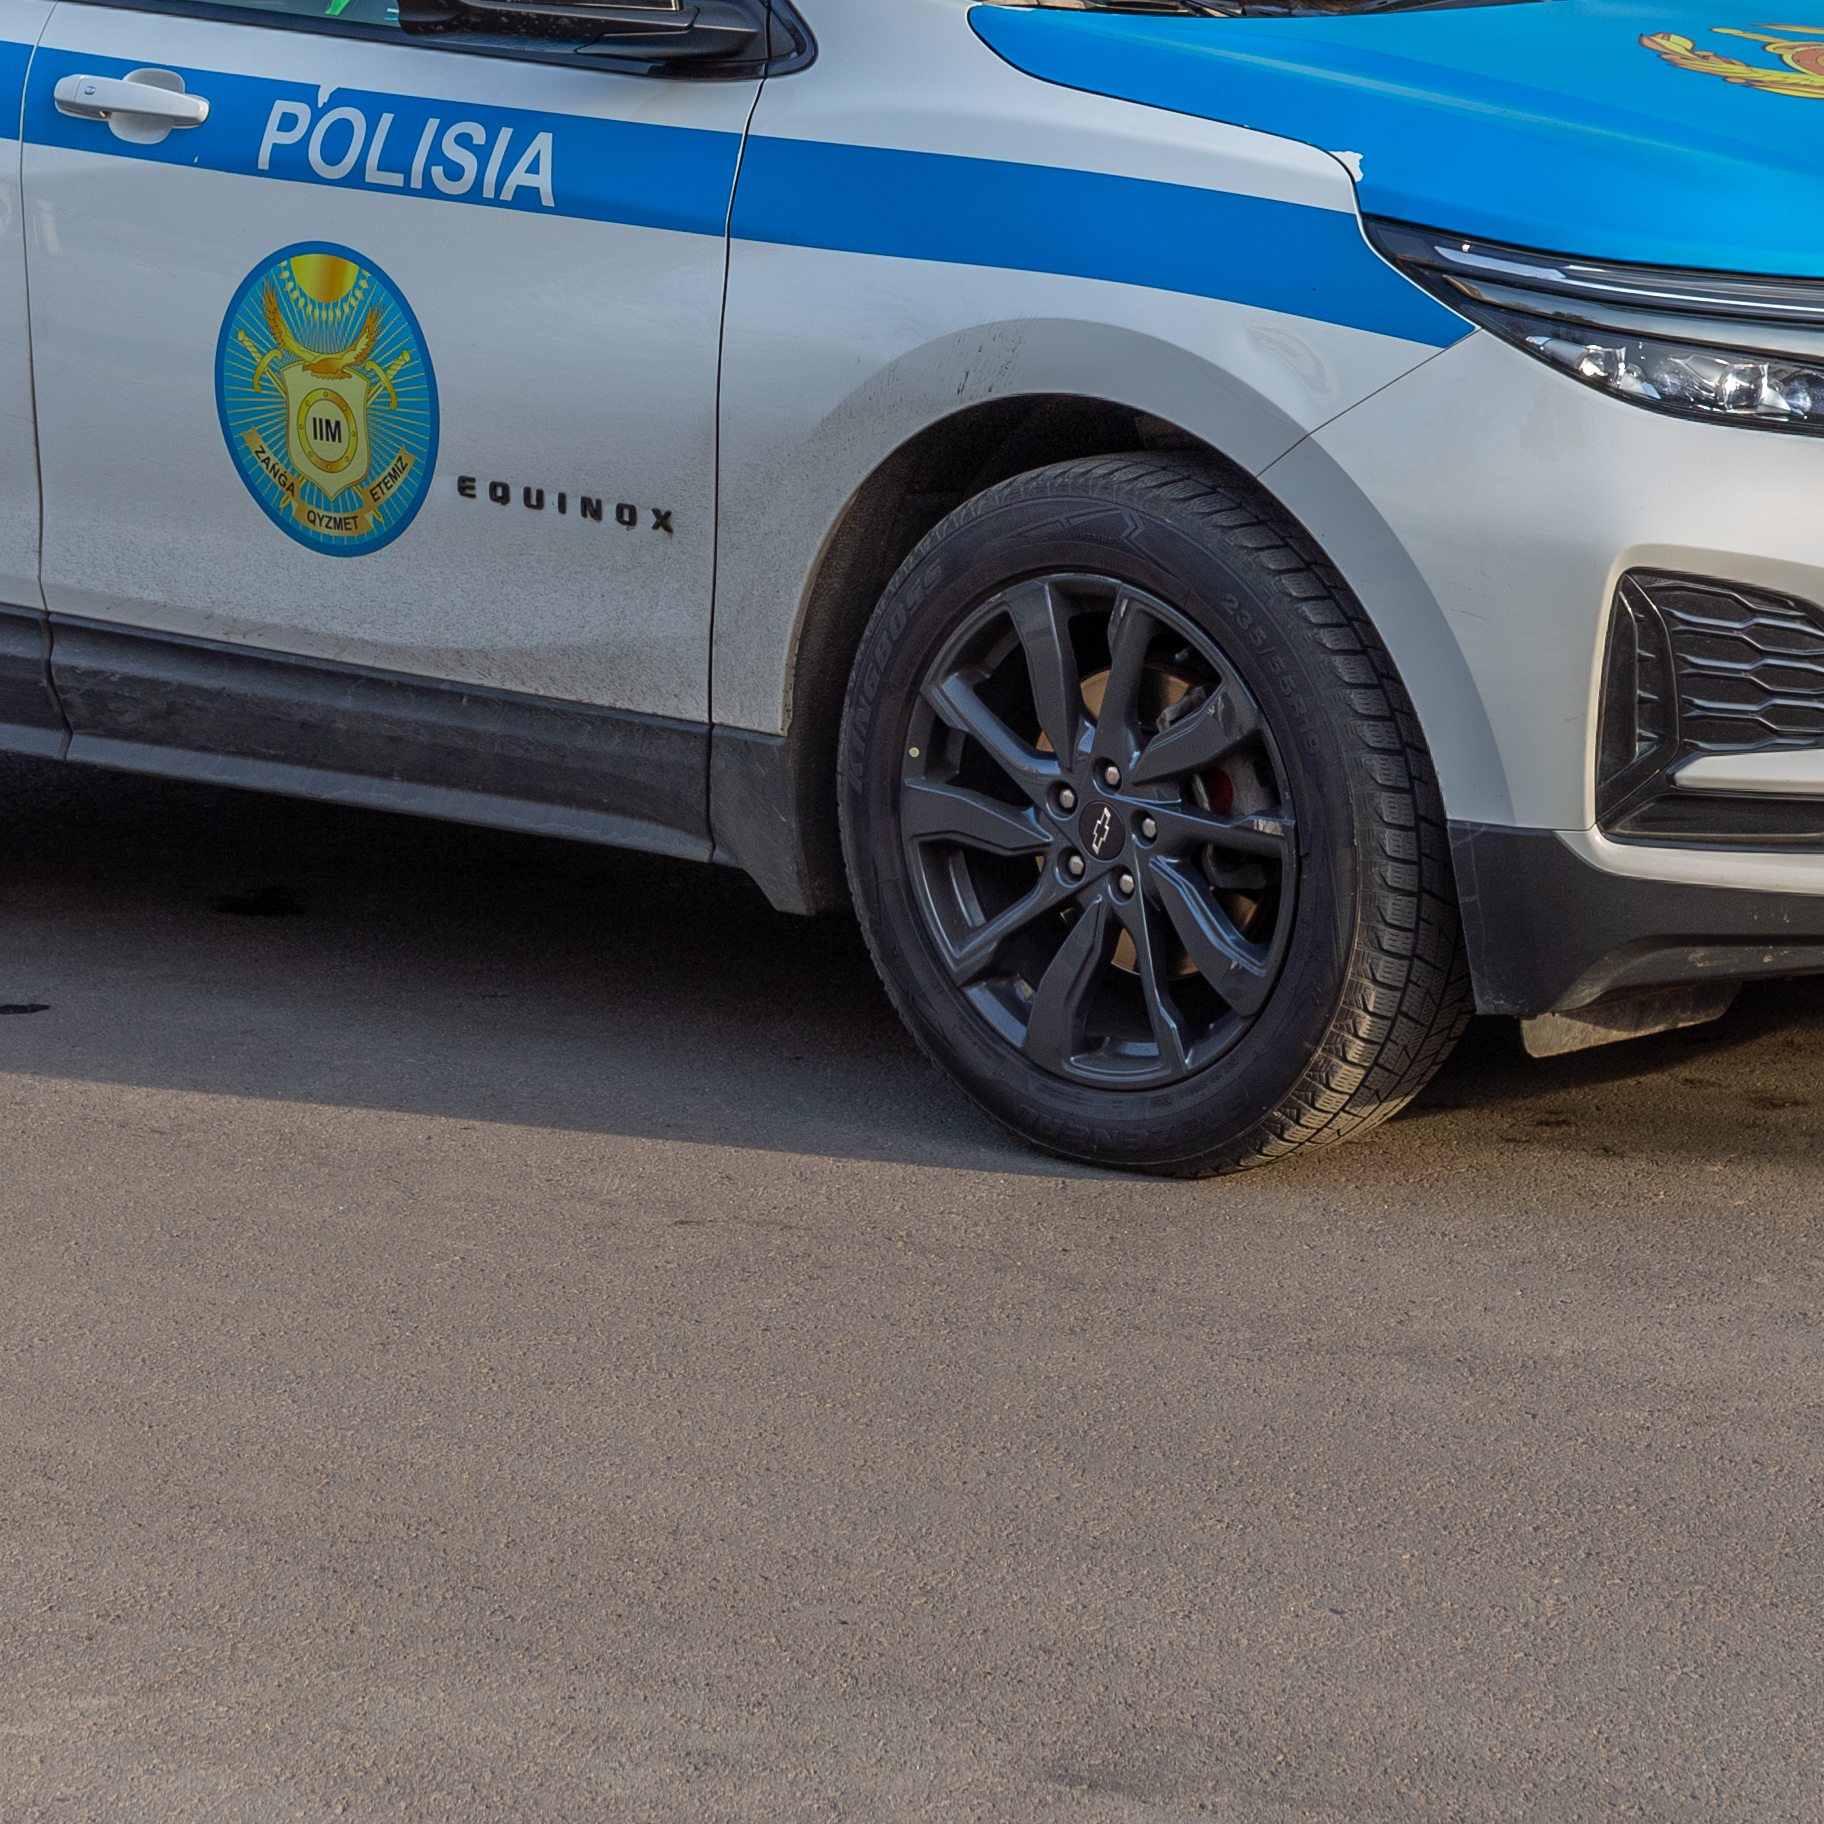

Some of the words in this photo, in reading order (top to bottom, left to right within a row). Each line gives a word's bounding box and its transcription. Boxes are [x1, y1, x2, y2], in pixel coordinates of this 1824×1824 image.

[257, 99, 555, 208] POLISIA
[312, 416, 343, 444] IIM
[306, 509, 360, 532] QYZMET
[368, 454, 409, 504] ETEMIZ
[457, 475, 674, 534] EQUINOX
[848, 556, 946, 796] KINGBOSS
[1218, 590, 1322, 756] 235/55R19
